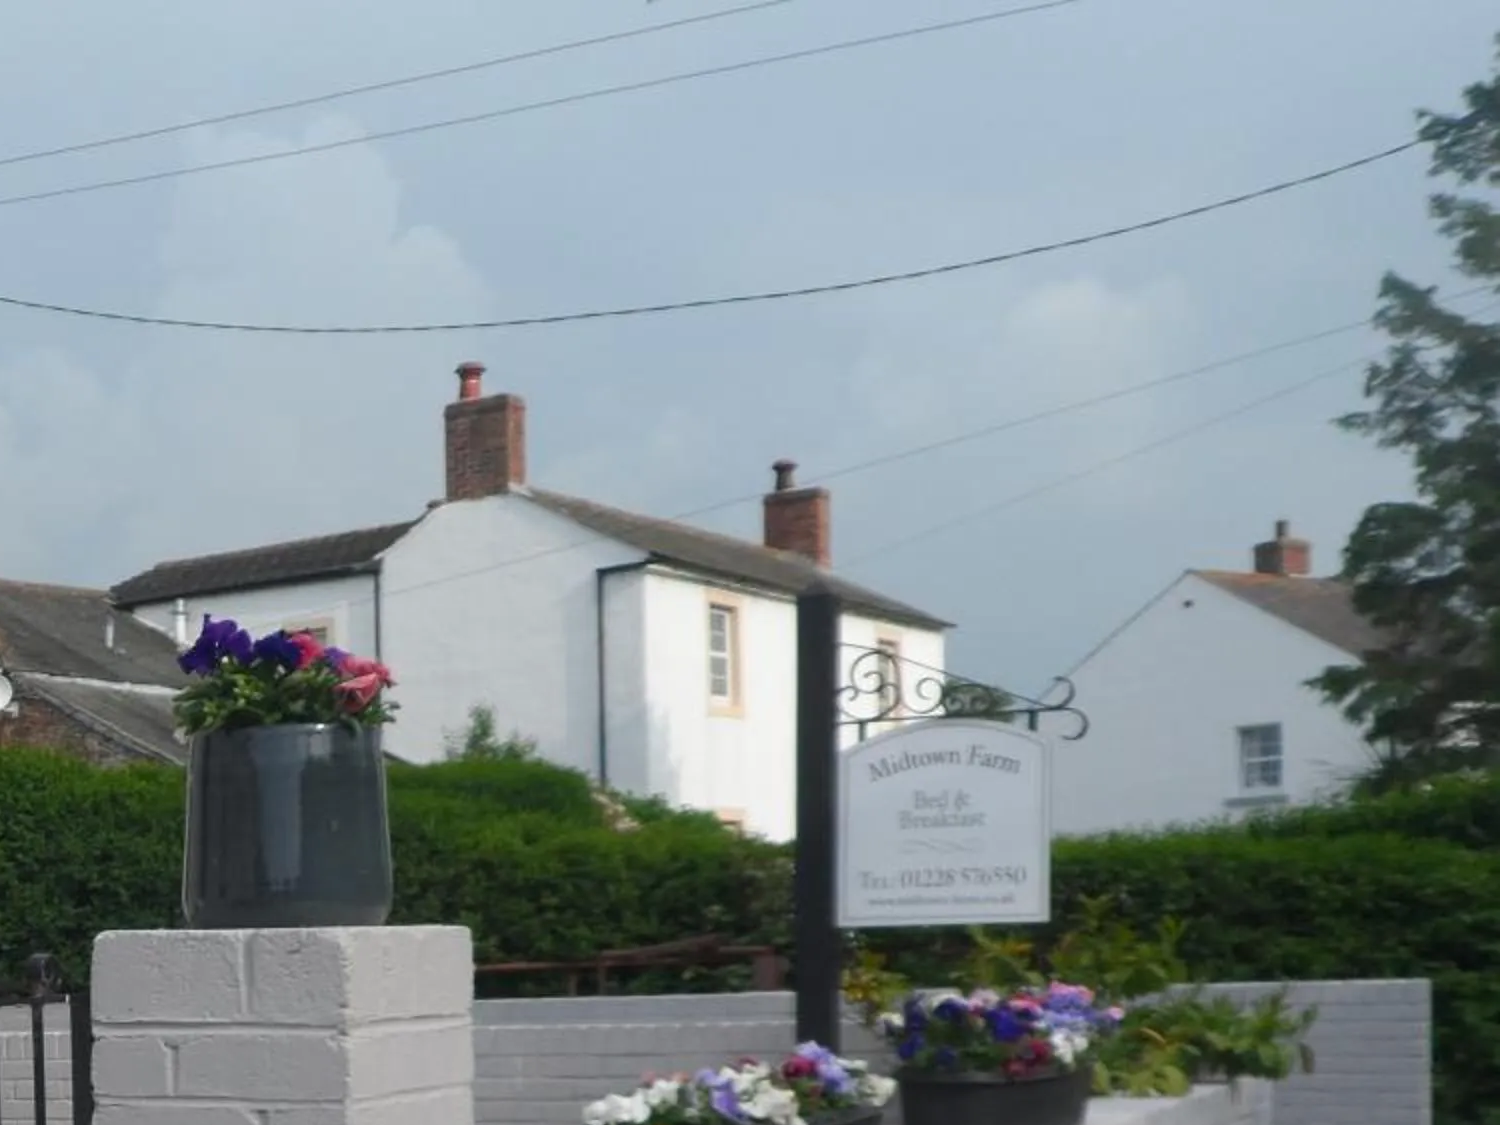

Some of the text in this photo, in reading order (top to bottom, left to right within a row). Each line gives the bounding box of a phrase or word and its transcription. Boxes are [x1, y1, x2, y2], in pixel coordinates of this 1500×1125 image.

[867, 744, 1022, 783] Midtown Farm
[913, 790, 949, 810] Bed
[899, 811, 986, 830] Breakfast
